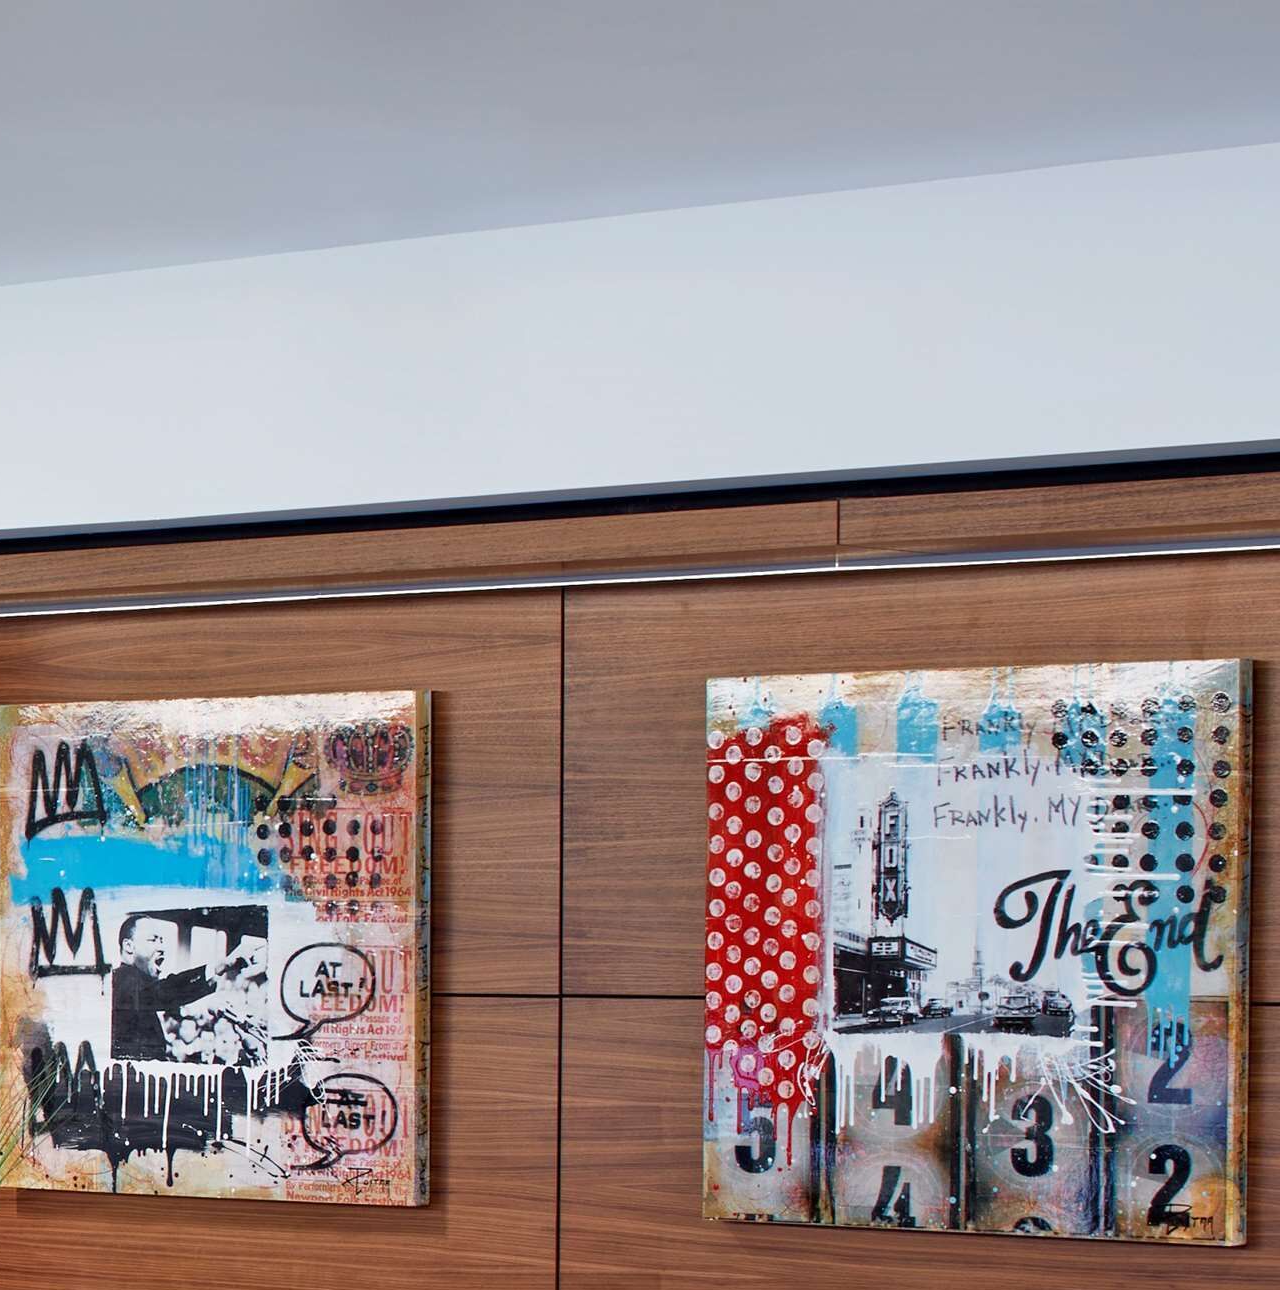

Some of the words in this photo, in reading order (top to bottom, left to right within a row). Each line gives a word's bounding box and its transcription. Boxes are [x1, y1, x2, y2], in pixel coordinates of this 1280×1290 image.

[363, 809, 413, 857] OUT
[1048, 794, 1081, 830] MY
[331, 886, 365, 899] Rights
[386, 886, 412, 897] 1964
[994, 869, 1103, 982] The
[1095, 879, 1225, 997] End
[315, 960, 343, 978] AT
[368, 1024, 384, 1034] Act
[1010, 1095, 1054, 1178] 3
[1147, 1145, 1192, 1226] 2
